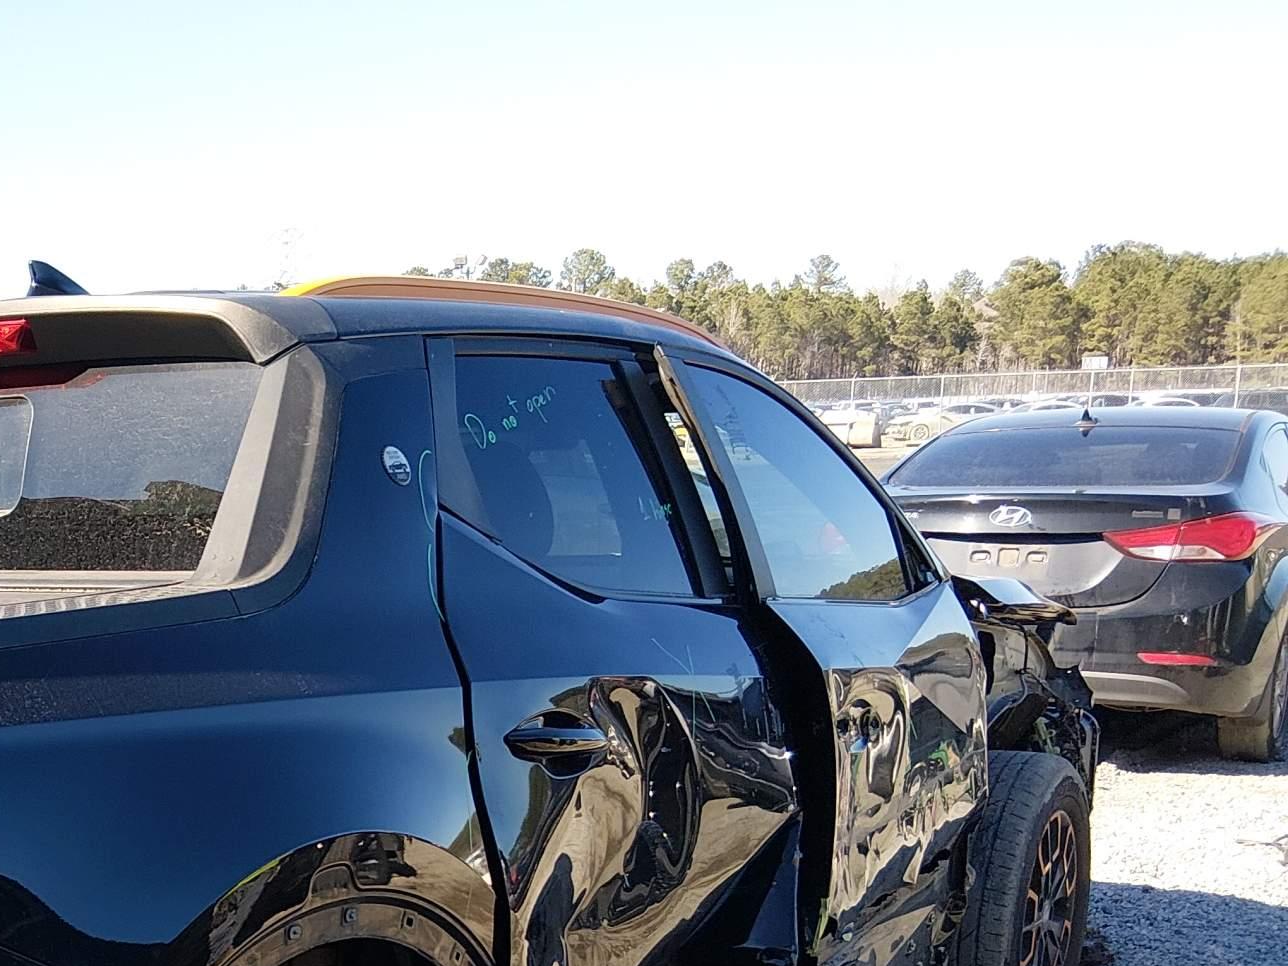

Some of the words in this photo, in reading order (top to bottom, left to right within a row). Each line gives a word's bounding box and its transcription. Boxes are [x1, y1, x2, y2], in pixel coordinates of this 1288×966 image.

[464, 413, 497, 450] Do
[501, 394, 519, 431] not
[526, 385, 557, 424] open
